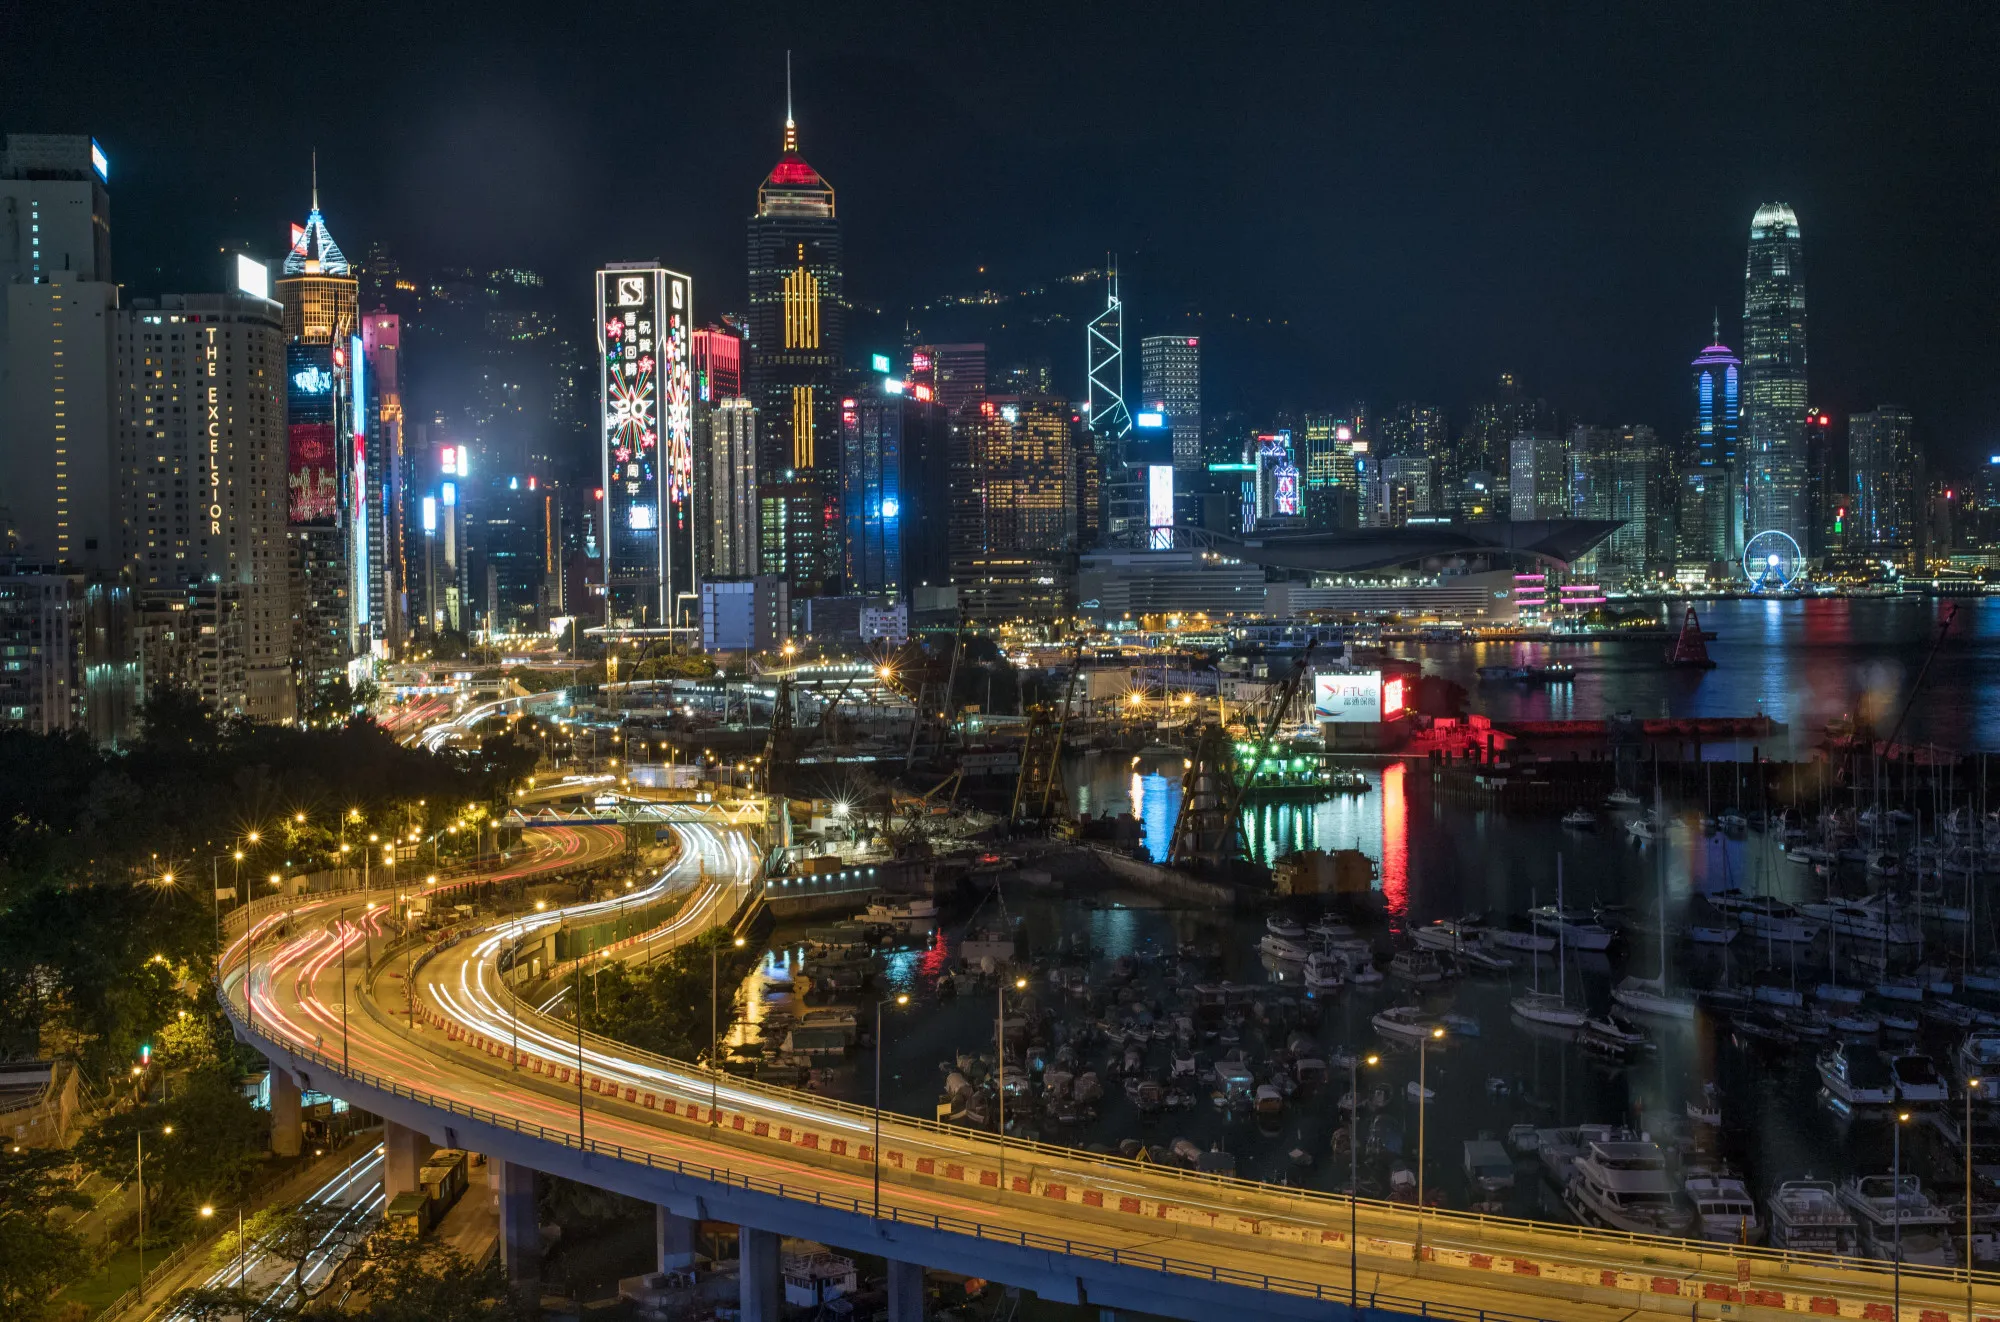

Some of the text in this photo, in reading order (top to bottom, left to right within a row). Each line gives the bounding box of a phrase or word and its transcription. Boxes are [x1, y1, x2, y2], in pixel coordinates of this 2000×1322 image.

[618, 399, 646, 419] 20
[206, 328, 222, 535] THE EXCELSIOR
[627, 464, 639, 496] 周年
[1343, 687, 1376, 696] FTLife
